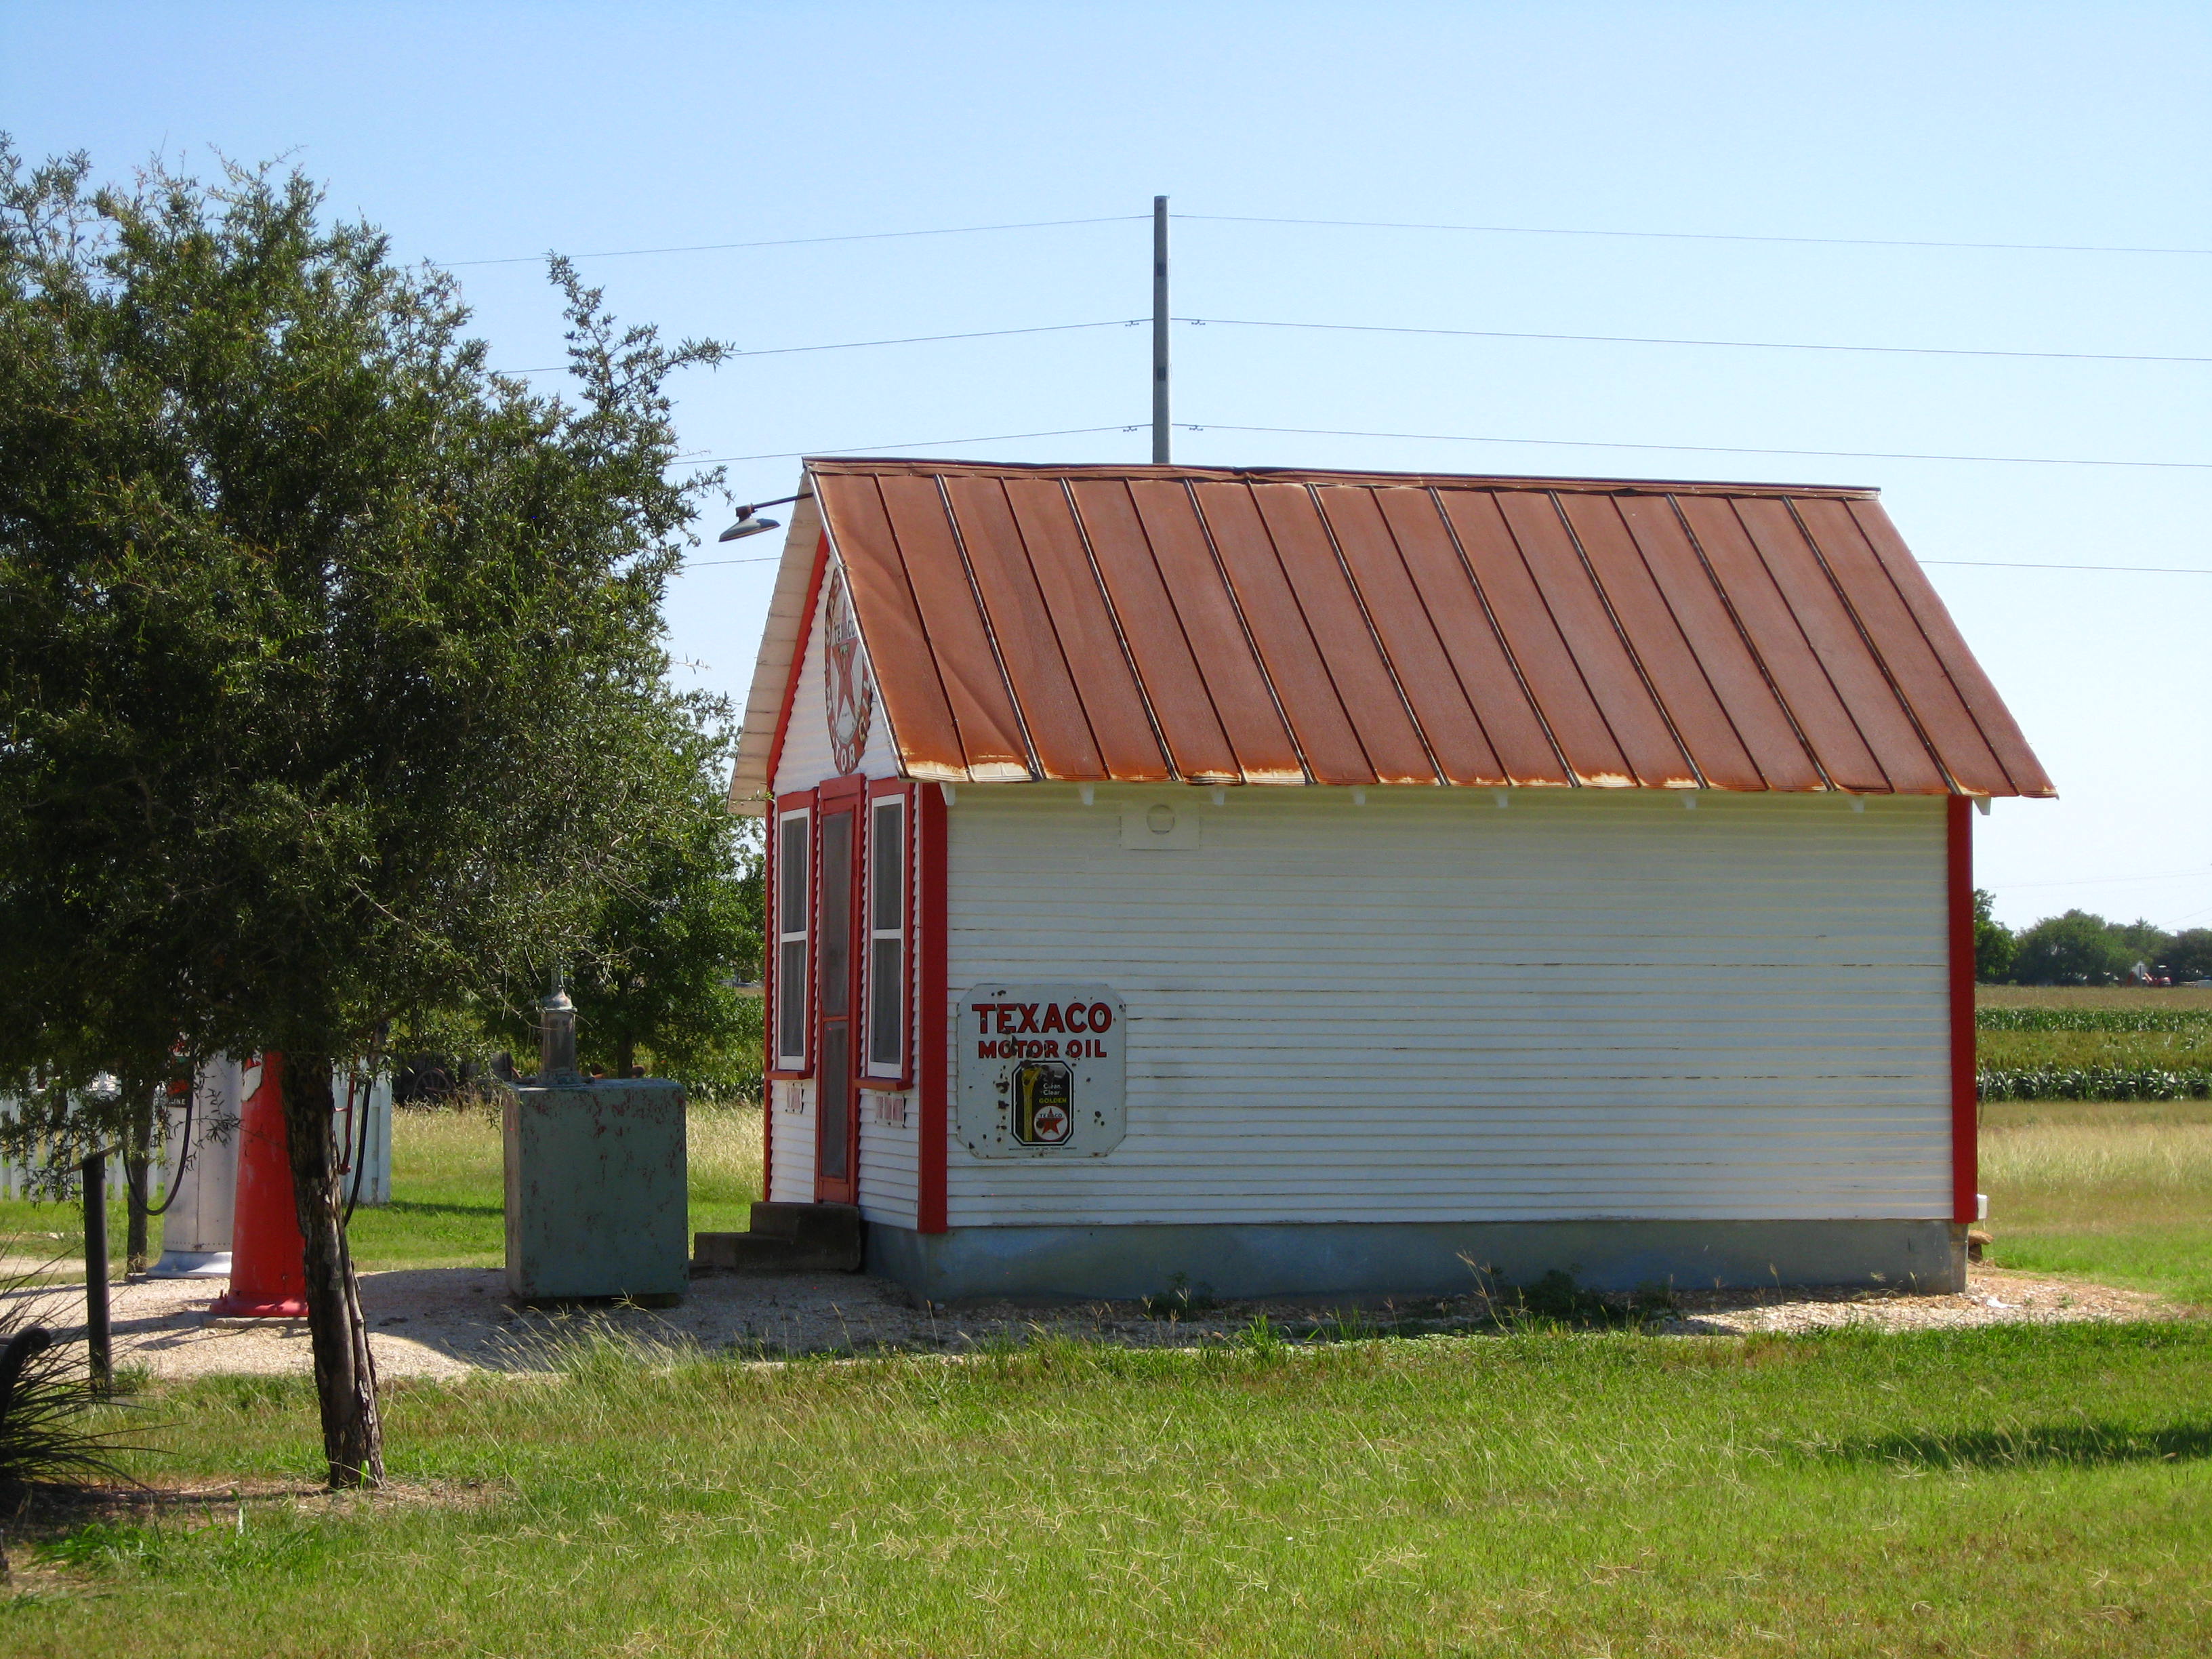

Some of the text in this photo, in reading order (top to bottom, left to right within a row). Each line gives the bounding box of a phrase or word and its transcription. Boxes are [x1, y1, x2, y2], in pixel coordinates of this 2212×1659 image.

[971, 1002, 1112, 1034] TEXACO
[978, 1039, 1107, 1059] MOTOR OIL
